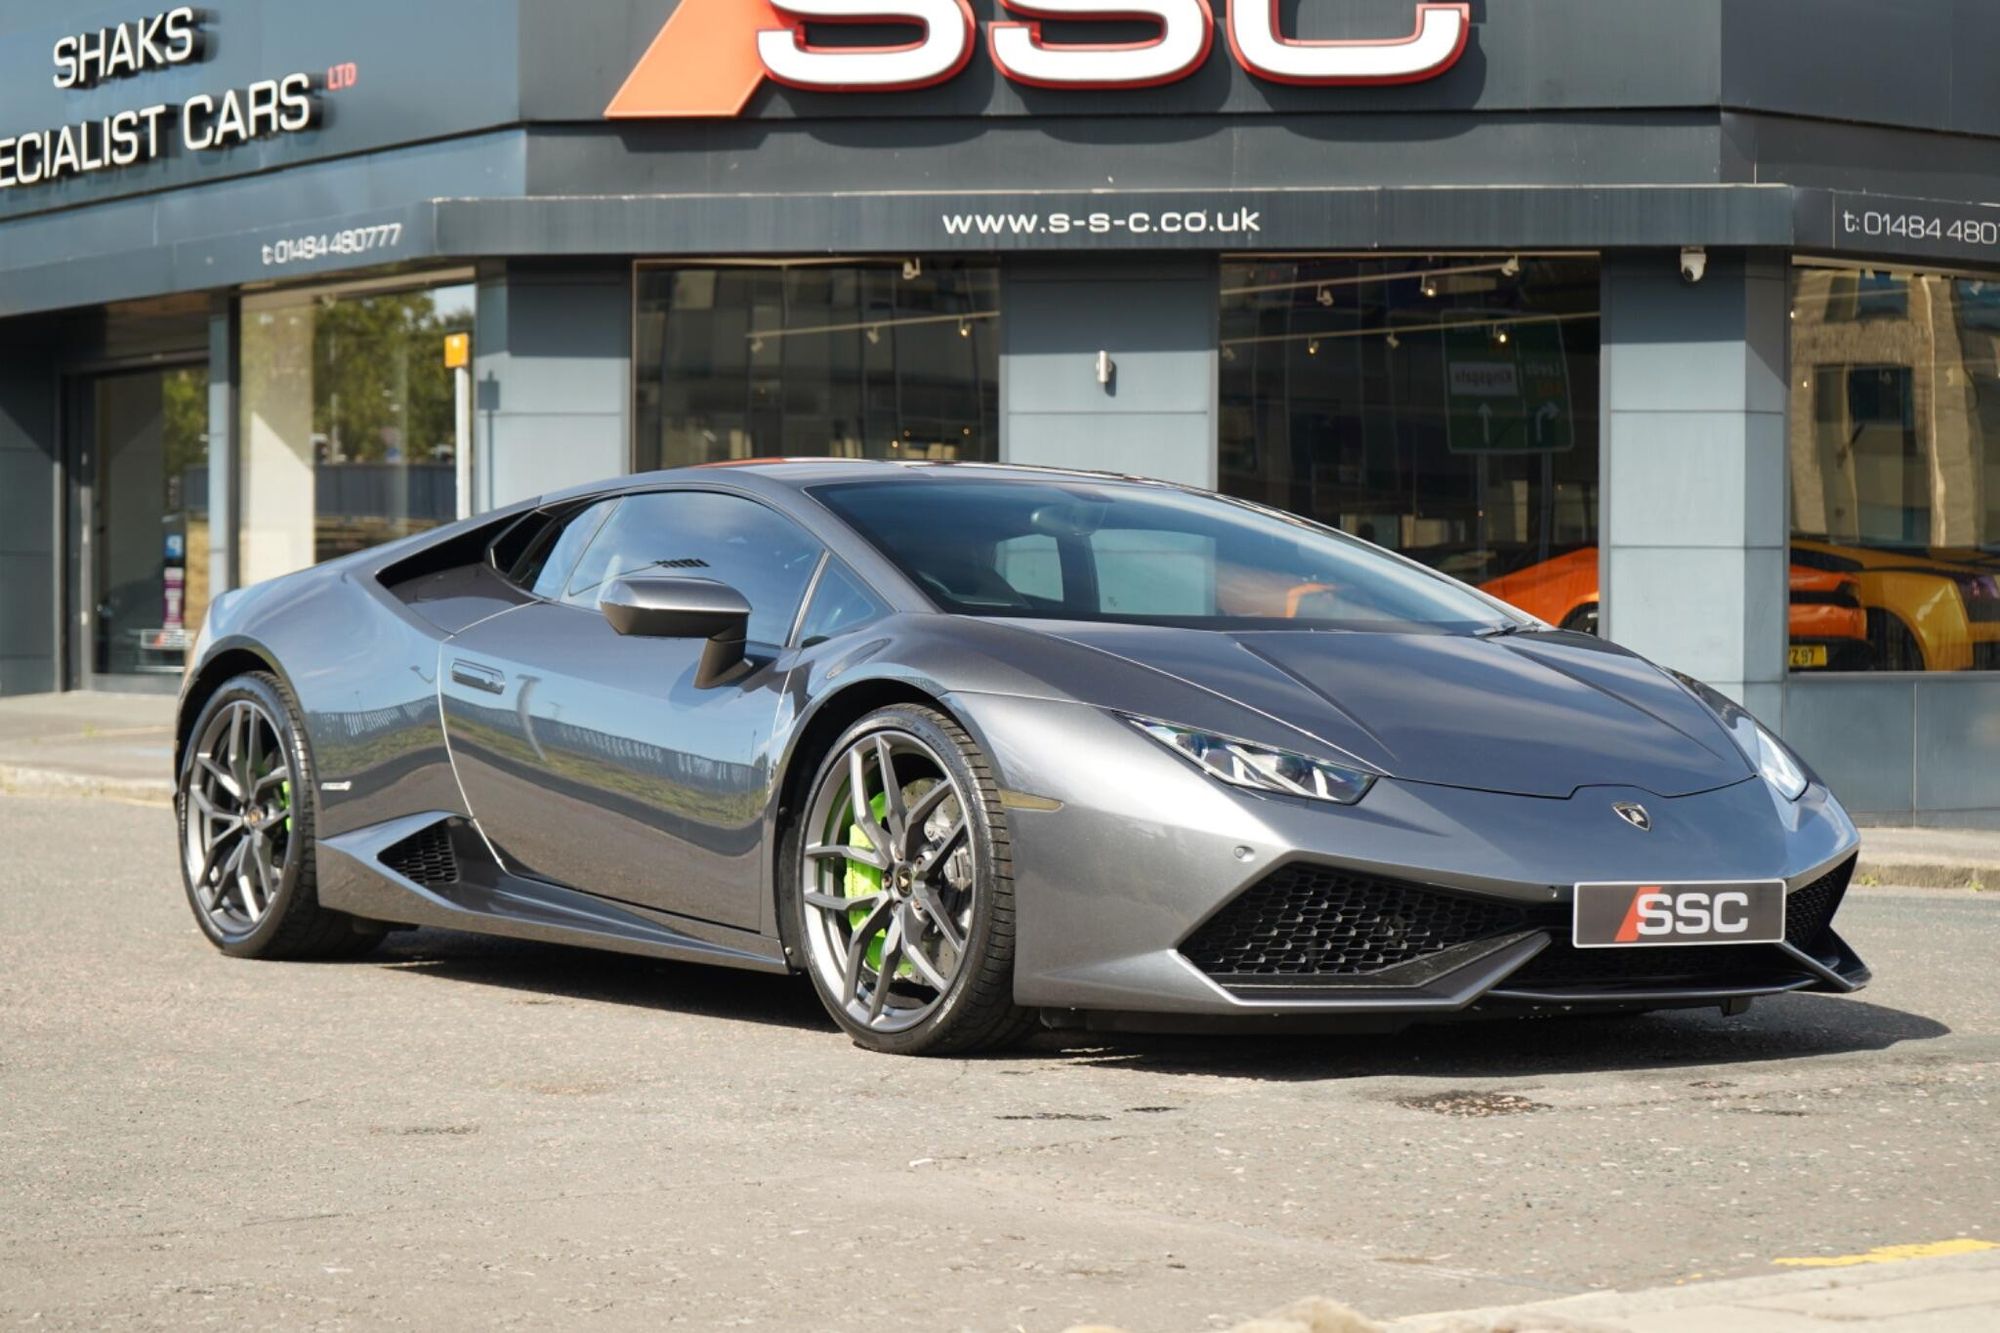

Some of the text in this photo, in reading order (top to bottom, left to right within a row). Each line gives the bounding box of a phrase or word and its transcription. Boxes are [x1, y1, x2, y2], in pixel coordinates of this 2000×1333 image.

[53, 6, 194, 88] SHAKS
[0, 62, 357, 188] ECIALIST CARS LTD
[942, 206, 1261, 235] www.s-s-c.co.uk
[1946, 219, 2000, 245] 480
[1635, 892, 1749, 936] SSC
